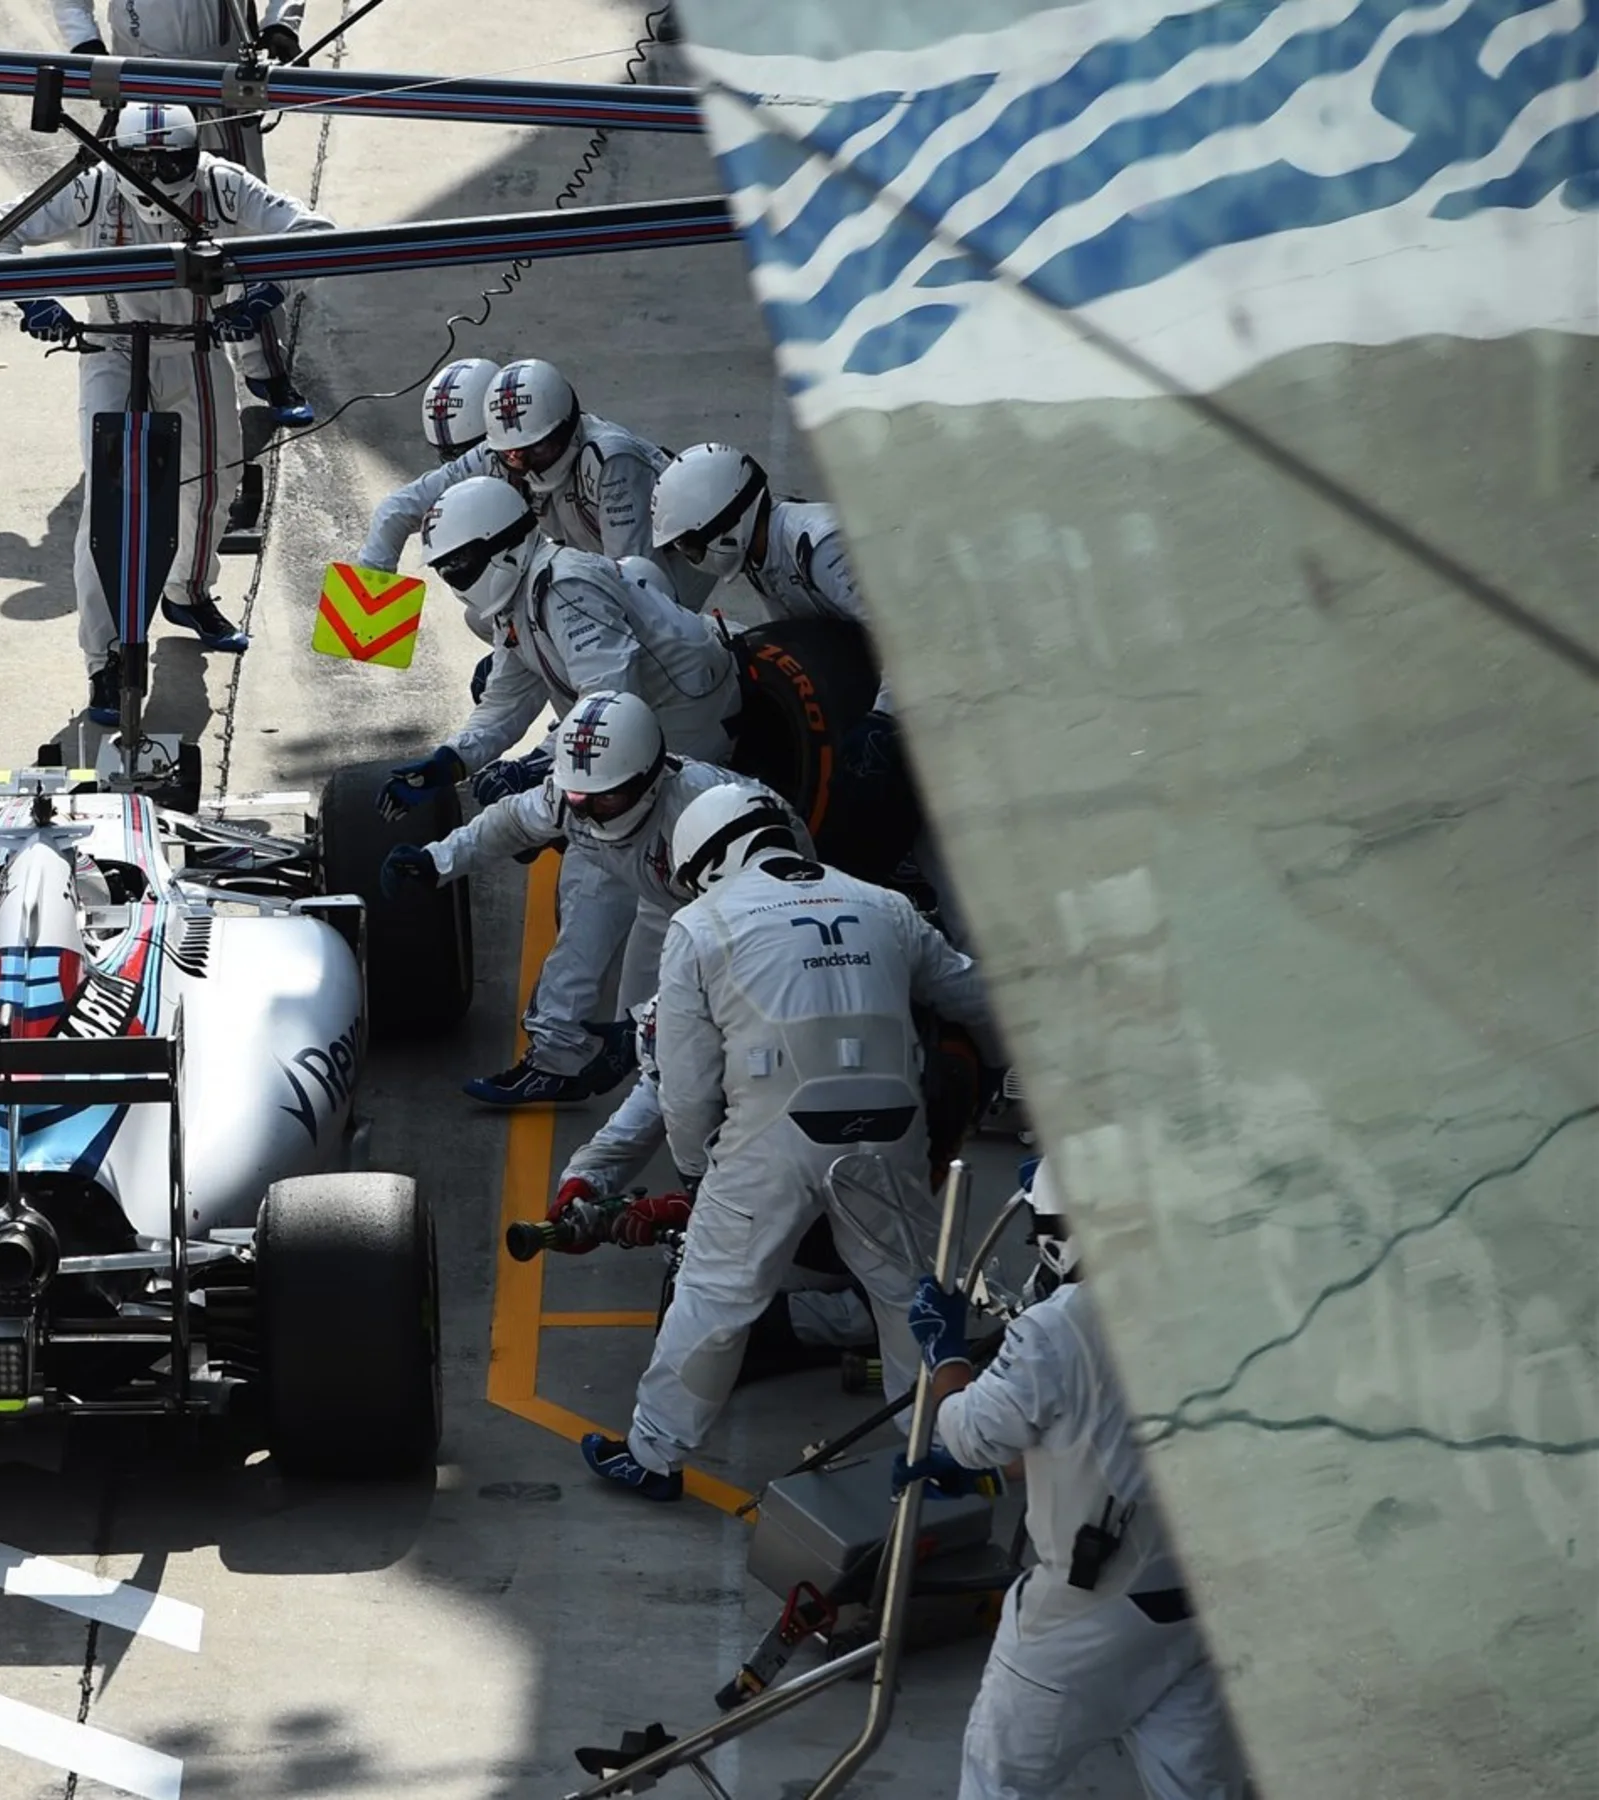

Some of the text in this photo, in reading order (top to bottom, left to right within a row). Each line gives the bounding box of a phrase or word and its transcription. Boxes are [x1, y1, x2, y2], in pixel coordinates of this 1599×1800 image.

[489, 395, 532, 411] MARTINI
[756, 643, 826, 732] ZERO
[564, 732, 610, 748] MARTINI
[802, 951, 871, 970] randstad
